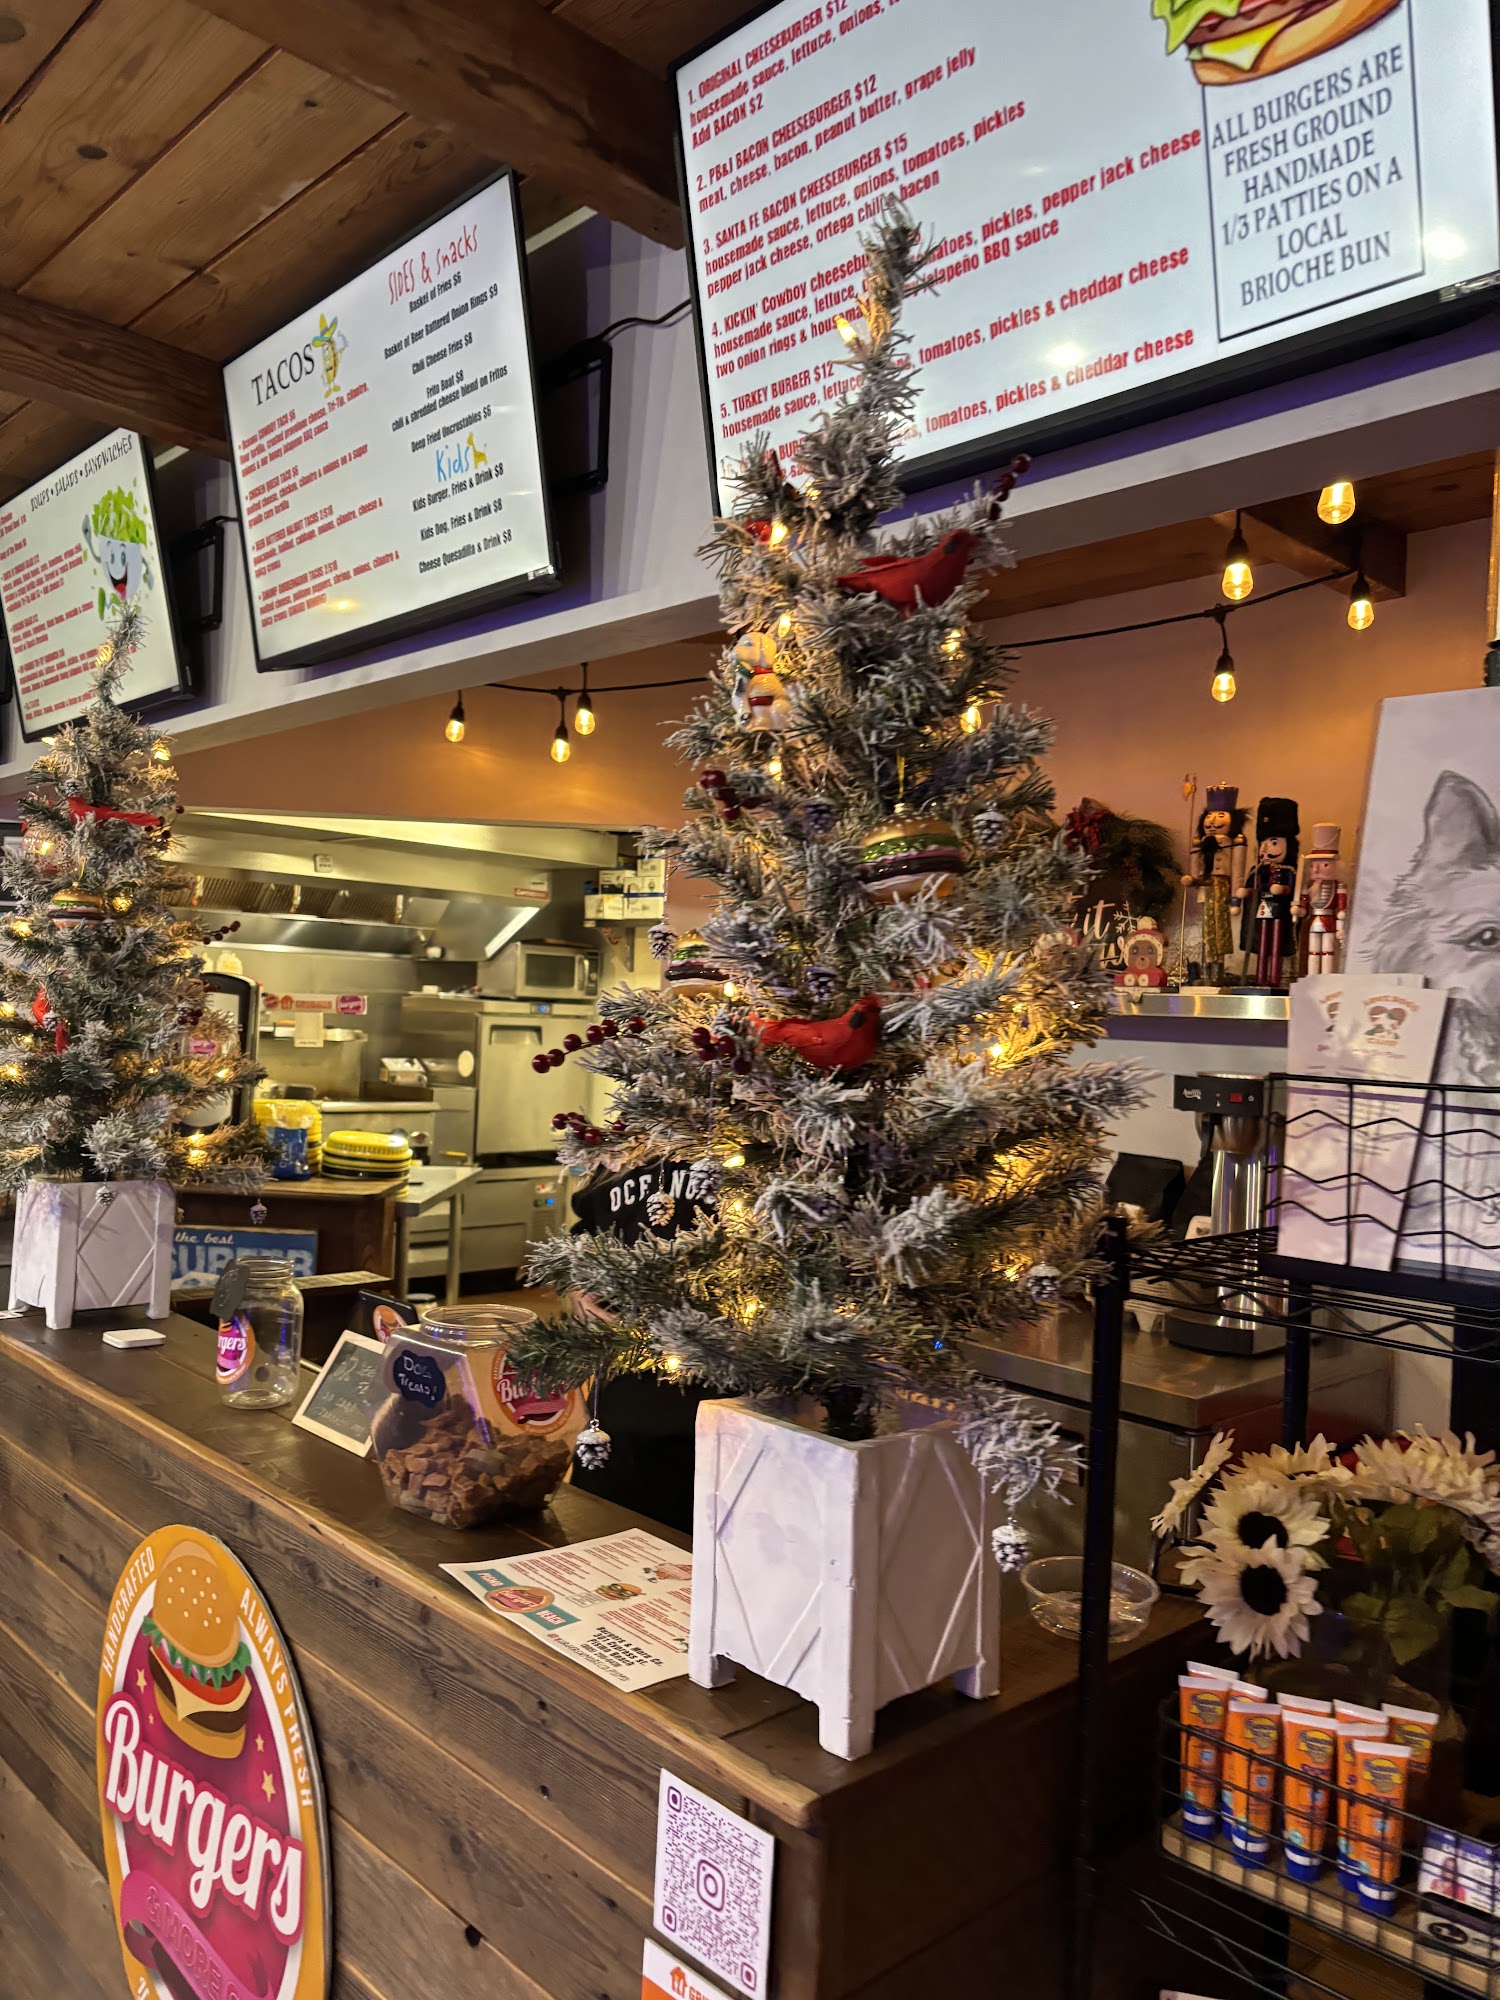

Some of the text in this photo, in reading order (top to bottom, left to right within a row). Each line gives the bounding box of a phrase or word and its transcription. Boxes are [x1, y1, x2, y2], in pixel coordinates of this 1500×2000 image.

[687, 88, 696, 106] 1.
[698, 58, 742, 100] ORIGINAL
[744, 5, 823, 70] CHEESEBURGER
[689, 0, 885, 128] housemade sauce, lettuce, onions,
[691, 91, 763, 150] Add BACON $2
[696, 72, 877, 193] 2. PB&J BACON CHEESEBURGER $12
[698, 44, 976, 215] meat, cheese, bacon, peanut butter, grape jelly
[1212, 45, 1404, 150] ALL BURGERS ARE
[1224, 86, 1392, 177] FRESH GROUND
[702, 131, 908, 256] 3. SANTA FE BACON CHEESEBURGER $15
[704, 97, 1025, 277] housemade sauce, lettuce, onions, tomatoes, pickles
[1221, 156, 1404, 247] 1/3 PATTIES ON A
[1243, 128, 1376, 203] HANDMADE
[706, 167, 940, 299] pepper jack cheese, ortega bacon
[713, 319, 773, 359] housemade
[775, 302, 812, 333] sauce,
[980, 199, 1037, 242] pickles,
[1041, 172, 1096, 214] pepper
[1099, 154, 1135, 188] jack
[1138, 124, 1202, 170] cheese
[1240, 231, 1392, 308] BRIOCHE BUN
[1276, 212, 1348, 260] LOCAL
[389, 259, 415, 305] SIDES
[421, 251, 432, 283] &
[408, 291, 429, 313] Basket
[429, 285, 437, 300] of
[436, 278, 452, 296] Fries
[710, 319, 722, 339] 4.
[760, 280, 807, 316] Cowboy
[715, 358, 735, 380] two
[736, 344, 766, 371] onion
[768, 331, 797, 357] rings
[798, 326, 807, 345] &
[982, 235, 1011, 265] BBQ
[1014, 215, 1060, 252] sauce
[383, 282, 498, 359] Basket of Beer Battered Onion Rings $9
[411, 358, 425, 375] Chili
[425, 347, 447, 367] Cheese
[447, 338, 463, 355] Fries
[721, 243, 1189, 440] housemade sauce, tomatoes, pickles & cheddar cheese
[251, 343, 315, 406] TACOS
[391, 416, 404, 432] chili
[409, 399, 437, 422] shredded
[437, 389, 460, 408] cheese
[460, 377, 479, 397] blend
[478, 374, 488, 388] on
[488, 364, 507, 382] Fritos
[425, 383, 440, 398] Frito
[440, 374, 455, 391] Boat
[719, 359, 833, 420] 5. TURKEY BURGER $12
[925, 326, 1195, 434] tomatoes, pickles & cheddar cheese
[83, 434, 133, 479] SANDWICHES
[410, 437, 426, 453] Deep
[425, 428, 441, 445] Fried
[441, 411, 481, 437] Uncrustables
[436, 442, 470, 483] Kids
[411, 461, 504, 512] Kids Burger, Fries & Drink $8
[419, 526, 434, 541] Kids
[449, 514, 466, 529] Fries
[467, 511, 473, 523] &
[473, 502, 492, 520] Drink
[492, 497, 503, 513] $8
[418, 528, 512, 573] Cheese Quesadilla & Drink $8
[175, 1231, 234, 1245] the best
[102, 1545, 156, 1679] HANDCRAFTED
[239, 1586, 314, 1809] ALWAYS FRESH
[104, 1698, 304, 1936] Burgers
